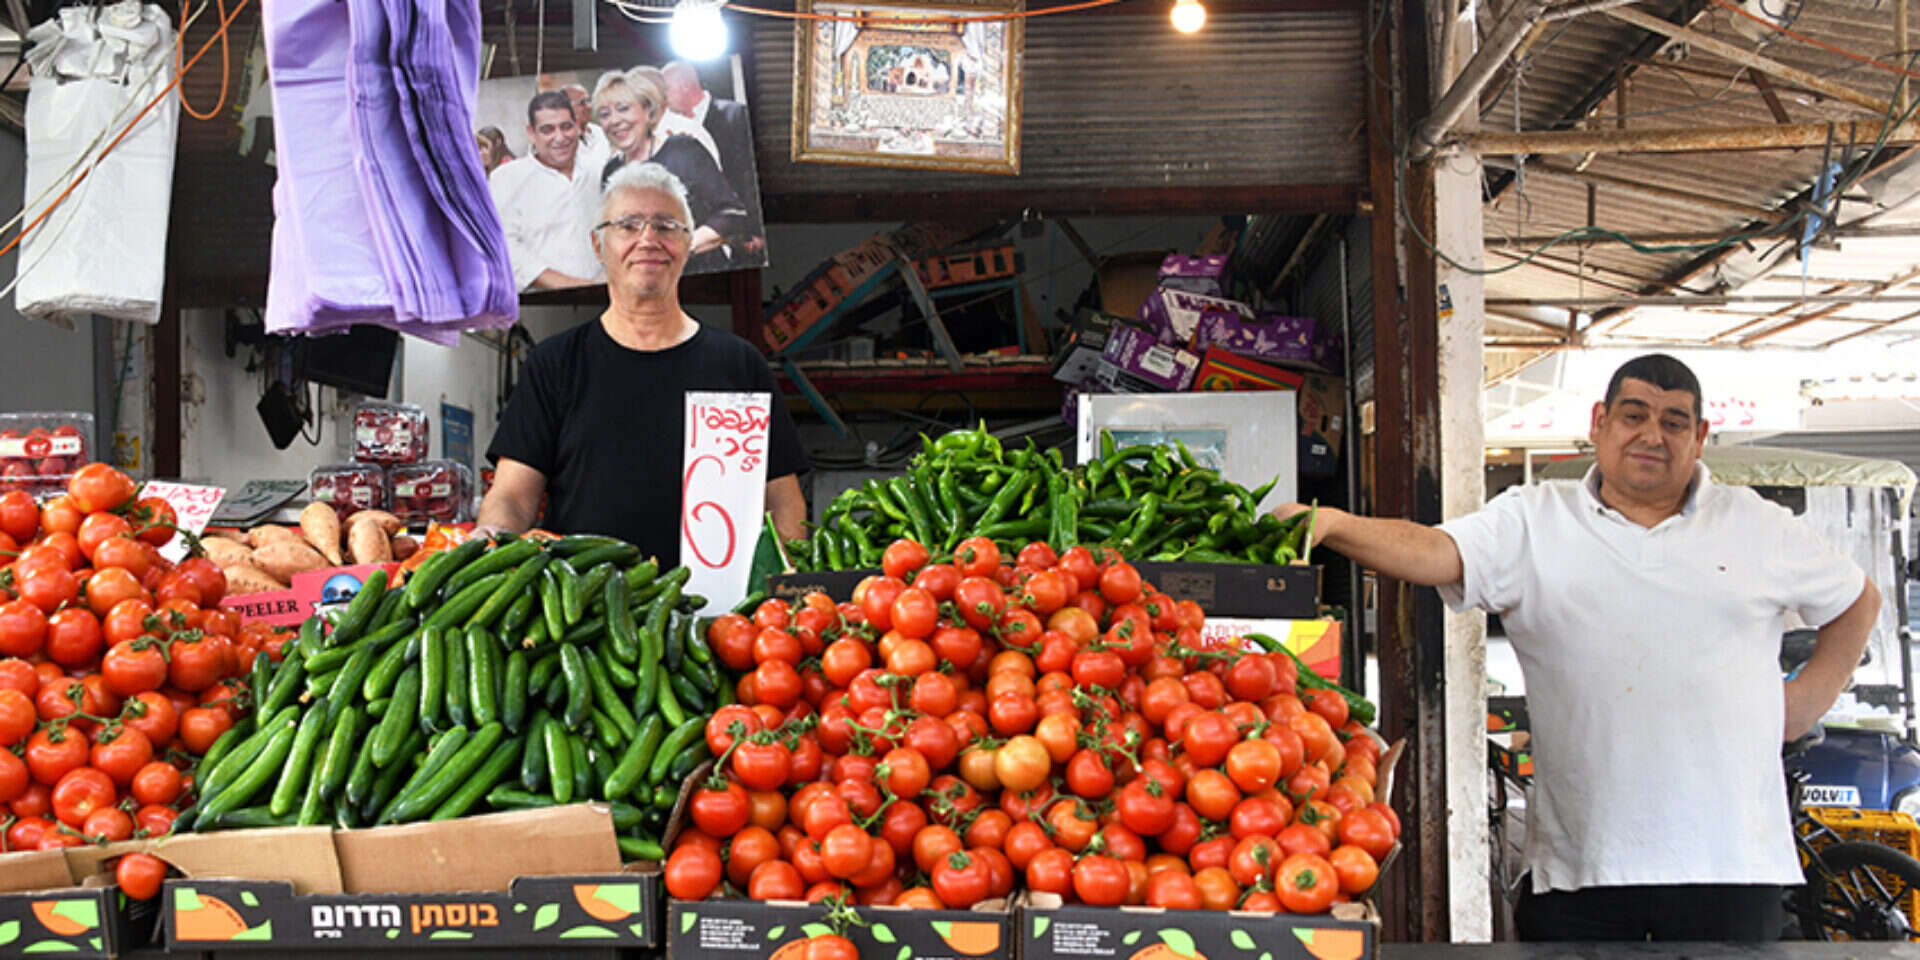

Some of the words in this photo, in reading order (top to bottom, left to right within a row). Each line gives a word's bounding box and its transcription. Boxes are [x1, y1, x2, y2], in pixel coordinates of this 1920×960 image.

[682, 456, 735, 569] 6
[1267, 578, 1287, 591] 8.3
[311, 904, 401, 927] הדרום
[410, 902, 499, 934] בוסתן
